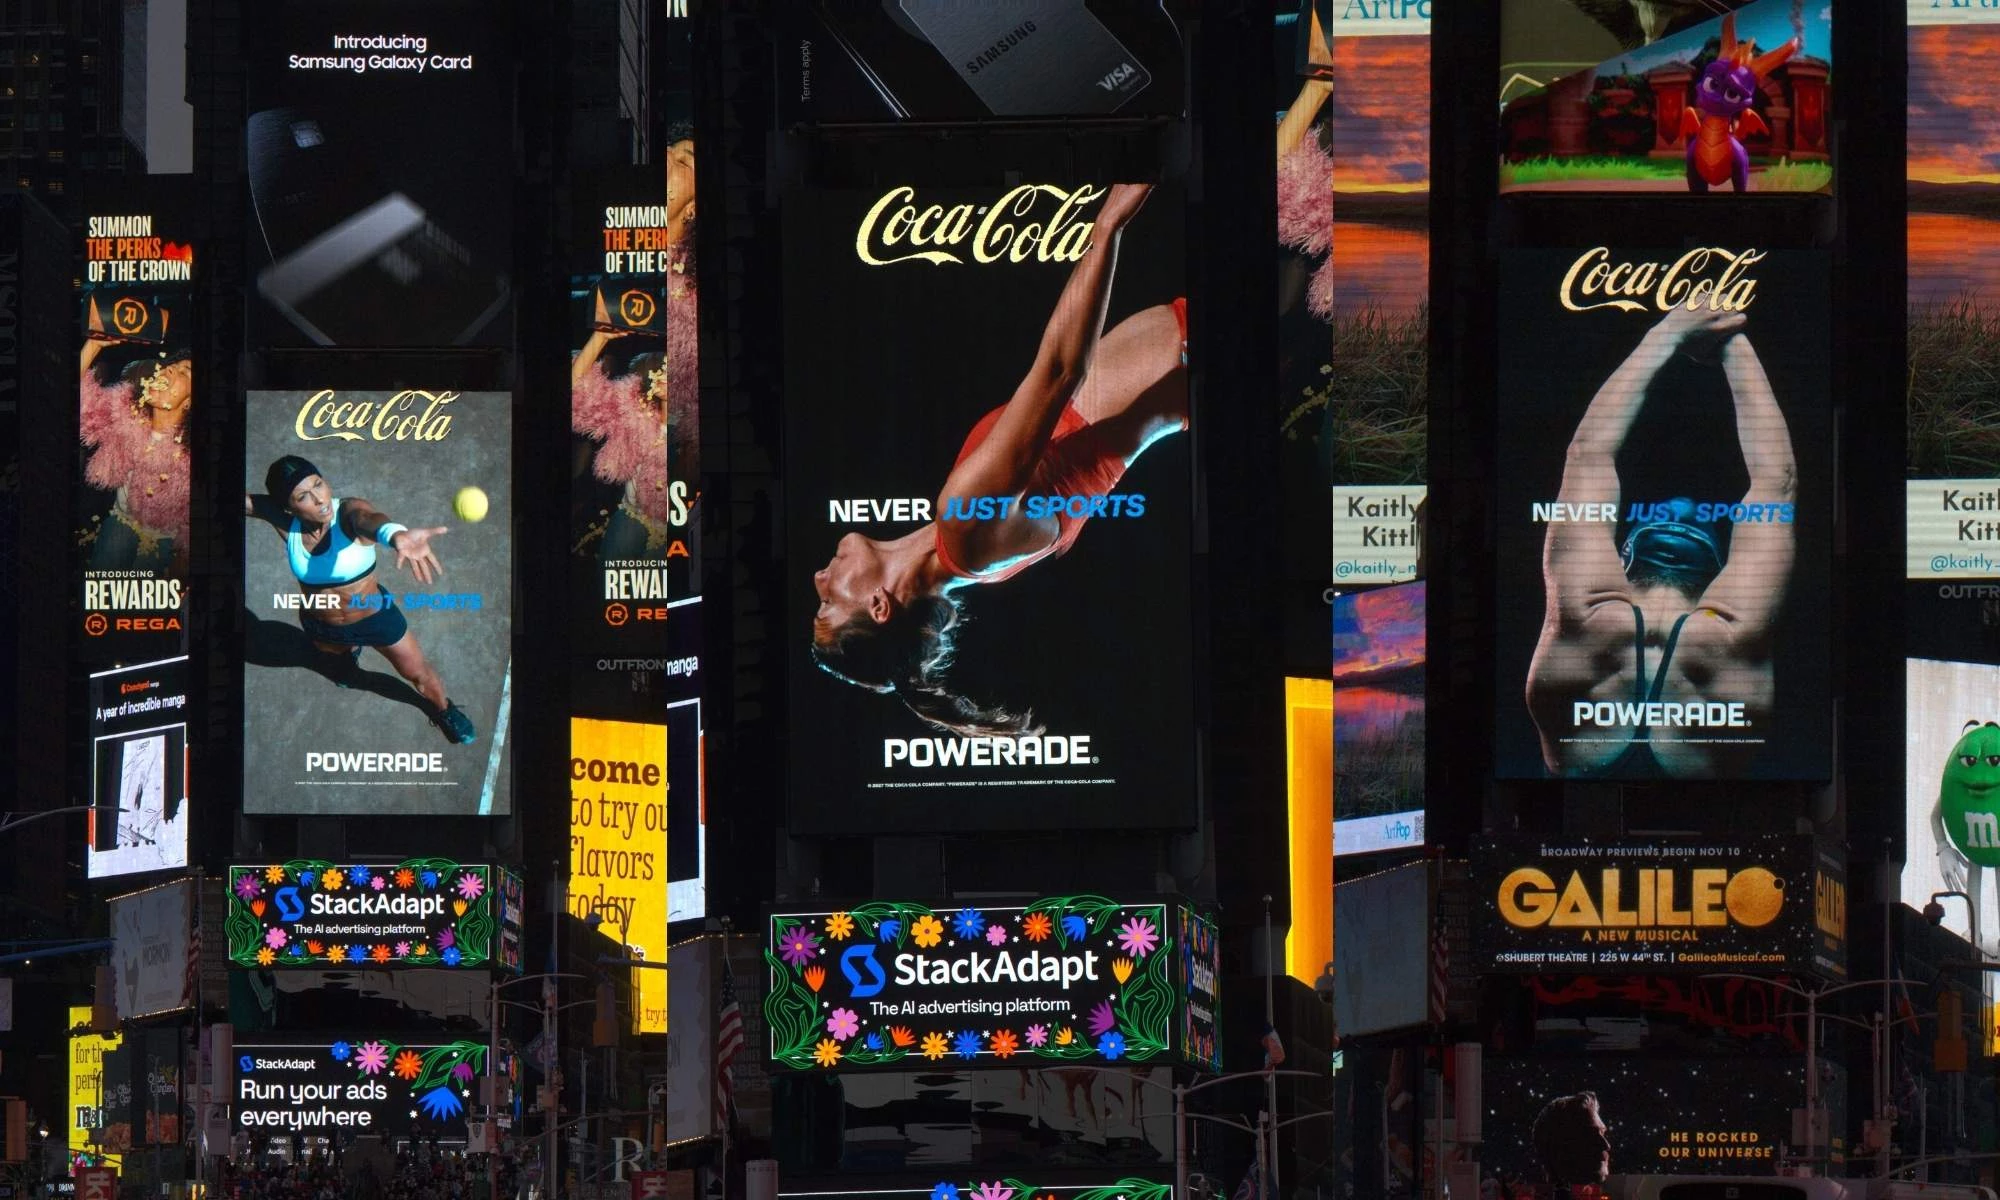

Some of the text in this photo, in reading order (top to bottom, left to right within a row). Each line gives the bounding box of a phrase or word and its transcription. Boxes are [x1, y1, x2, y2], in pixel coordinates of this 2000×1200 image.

[333, 35, 427, 53] Introducing
[966, 20, 1037, 74] SAMSUNG
[289, 55, 472, 73] Samsung Galaxy Card
[801, 39, 812, 101] Terms apply
[1095, 62, 1135, 91] VISA
[88, 216, 152, 237] SUMMON
[856, 184, 1106, 265] Coca-Cola
[86, 238, 162, 259] THE PERKS
[603, 229, 631, 251] THE
[88, 260, 191, 282] OF THE CROWN
[605, 252, 623, 273] OF
[627, 251, 655, 273] THE
[1559, 246, 1767, 312] Coca-Cola
[295, 388, 459, 442] Coca-Cola
[829, 494, 1145, 522] NEVER JUST SPORTS
[1532, 502, 1795, 522] NEVER JUST SPORTS
[85, 579, 181, 610] REWARDS
[273, 594, 483, 610] NEVER JUST SPORTS
[116, 618, 181, 630] REGA
[637, 608, 667, 620] RE
[596, 659, 667, 671] OUTFRON
[96, 695, 186, 721] A year of incredible manga
[571, 757, 660, 787] come
[599, 792, 639, 840] try
[1384, 821, 1411, 840] ArtPop
[1541, 847, 1741, 857] BROADWAY PREVIEWS BEGIN NOV 10
[309, 892, 444, 918] StackAdapt
[1498, 867, 1785, 927] GALILEO
[294, 923, 426, 938] The AI advertising platform
[1582, 930, 1699, 942] A NEW MUSICAL
[895, 950, 1098, 988] StackAdapt
[1504, 952, 1546, 964] SHUBERT
[1548, 952, 1588, 963] THEATRE
[1600, 952, 1617, 963] 225
[1620, 952, 1631, 963] W
[1653, 952, 1668, 963] ST.
[646, 1008, 661, 1027] try
[870, 997, 1070, 1019] The AI advertising platform
[75, 1043, 90, 1063] for
[256, 1058, 316, 1071] StackAdapt
[241, 1079, 387, 1104] Run your ads
[241, 1106, 371, 1131] everywhere
[1670, 1132, 1759, 1143] HE ROCKED
[1659, 1147, 1771, 1158] OUR UNIVERSE
